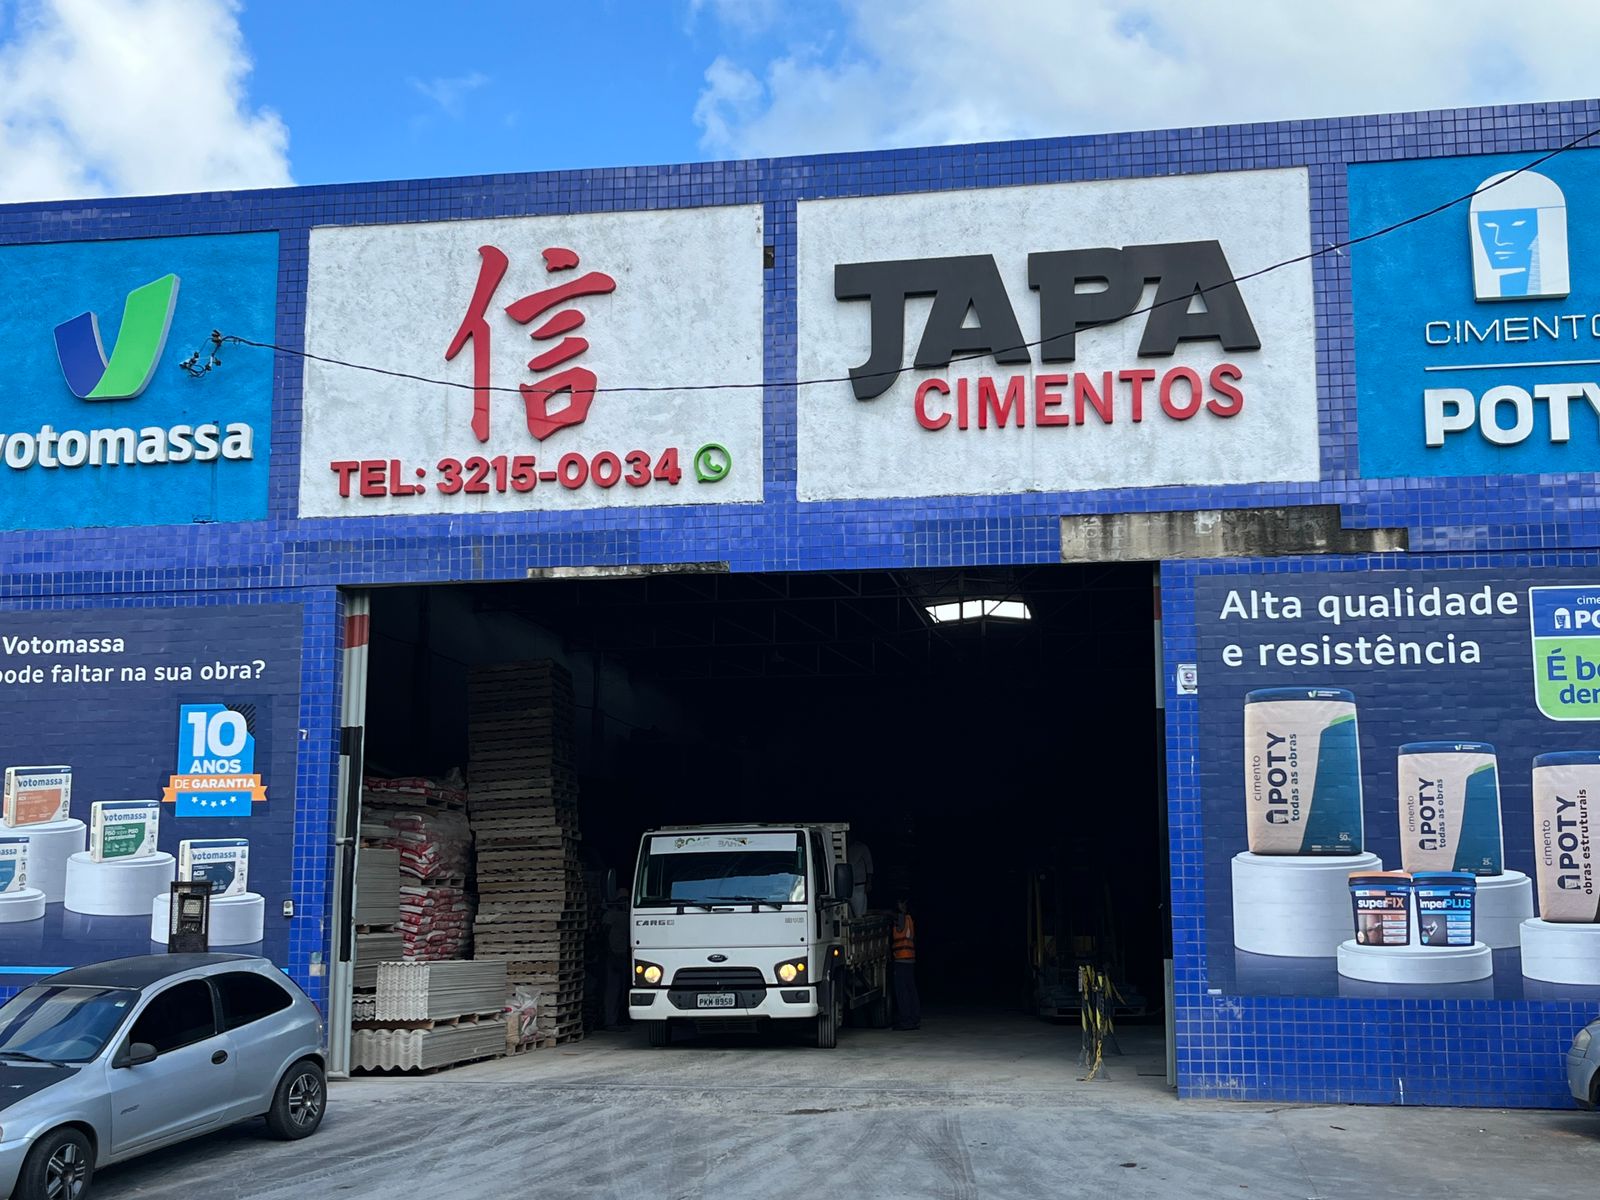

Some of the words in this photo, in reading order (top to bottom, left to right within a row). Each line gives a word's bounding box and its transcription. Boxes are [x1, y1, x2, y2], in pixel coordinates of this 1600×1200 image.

[834, 239, 1262, 401] JAPA
[445, 245, 617, 443] 信
[914, 363, 1245, 431] CIMENTOS
[0, 422, 254, 470] otomassa
[331, 459, 426, 498] TEL:
[436, 447, 682, 494] 3215-0034
[1219, 590, 1302, 620] Alta
[1318, 585, 1518, 625] qualidade
[2, 635, 125, 655] Votomassa
[1222, 643, 1243, 667] e
[1259, 633, 1481, 666] resistência
[0, 664, 45, 684] ode
[51, 664, 114, 683] faltar
[121, 667, 146, 681] na
[154, 666, 192, 681] sua
[200, 659, 266, 680] obra?
[1547, 647, 1568, 681] É
[187, 710, 248, 757] 10
[1288, 733, 1298, 768] obras
[17, 777, 63, 788] votomassa
[174, 779, 190, 789] DE
[191, 778, 256, 789] GARANTIA
[189, 759, 242, 774] ANOS
[1252, 755, 1262, 802] cimento
[1266, 731, 1289, 805] POTY
[1290, 771, 1299, 785] as
[1290, 788, 1300, 822] todas
[1418, 777, 1437, 835] POTY
[1436, 778, 1444, 806] obras
[104, 812, 147, 822] votomassa
[1407, 795, 1416, 832] cimento
[1577, 788, 1591, 860] estruturais
[1438, 821, 1447, 848] todas
[1542, 819, 1552, 867] cimento
[1556, 795, 1580, 870] POTY
[0, 848, 17, 856] assa
[192, 850, 237, 861] votomassa
[1583, 863, 1593, 895] obras
[1358, 897, 1404, 910] superFIX
[636, 919, 675, 927] CARGO
